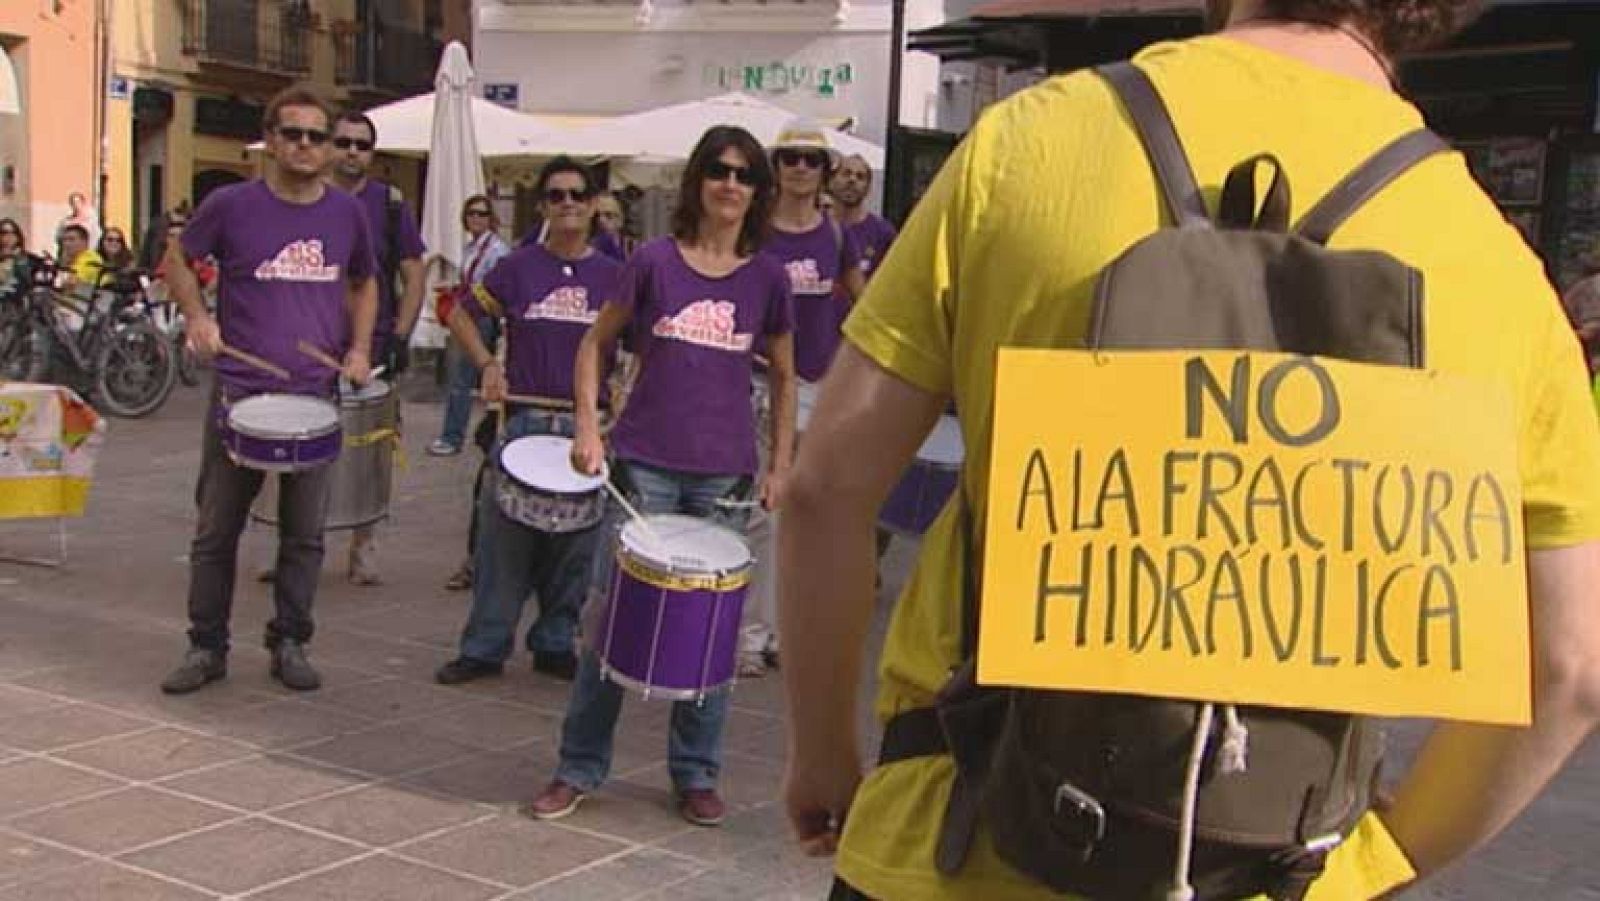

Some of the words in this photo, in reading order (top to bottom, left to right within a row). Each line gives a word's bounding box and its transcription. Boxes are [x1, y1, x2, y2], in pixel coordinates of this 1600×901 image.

[1184, 353, 1341, 447] NO
[1016, 448, 1058, 535] A
[1071, 447, 1141, 537] LA
[1161, 450, 1513, 564] FRACTURA
[1034, 541, 1463, 672] HIDRÁULICA
